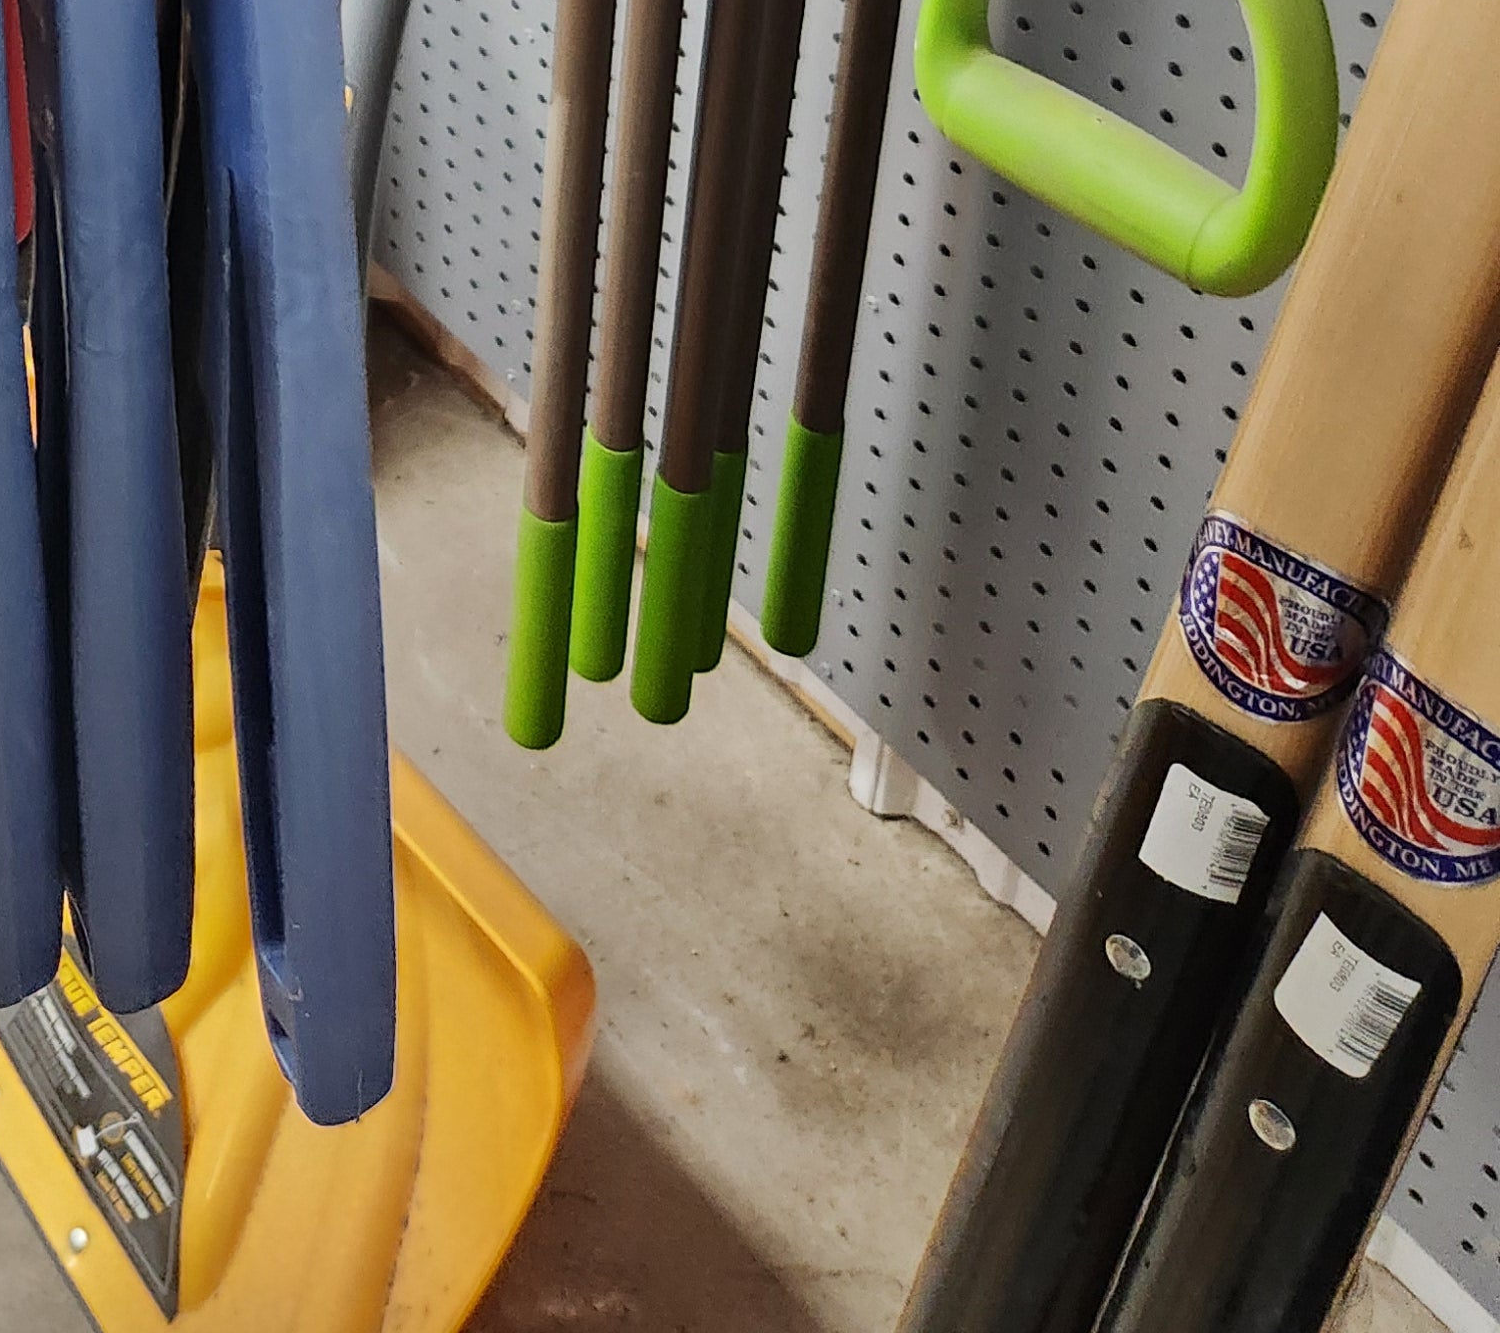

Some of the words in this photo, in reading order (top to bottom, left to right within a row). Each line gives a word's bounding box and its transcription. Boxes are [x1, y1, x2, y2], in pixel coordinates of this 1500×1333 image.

[1233, 534, 1358, 610] MANUFAC
[1283, 610, 1333, 633] MADE
[1181, 614, 1301, 719] EDDINGTON,
[1288, 636, 1346, 664] USA
[1388, 663, 1500, 767] MANUFAC
[1424, 738, 1500, 784] PROUDLY
[1427, 756, 1479, 788] MADE
[1187, 782, 1202, 801] EA
[1427, 768, 1449, 785] IN
[1450, 779, 1487, 802] THE
[1431, 783, 1499, 826] USA
[1329, 939, 1347, 959] EA
[86, 1003, 173, 1112] TEMPER
